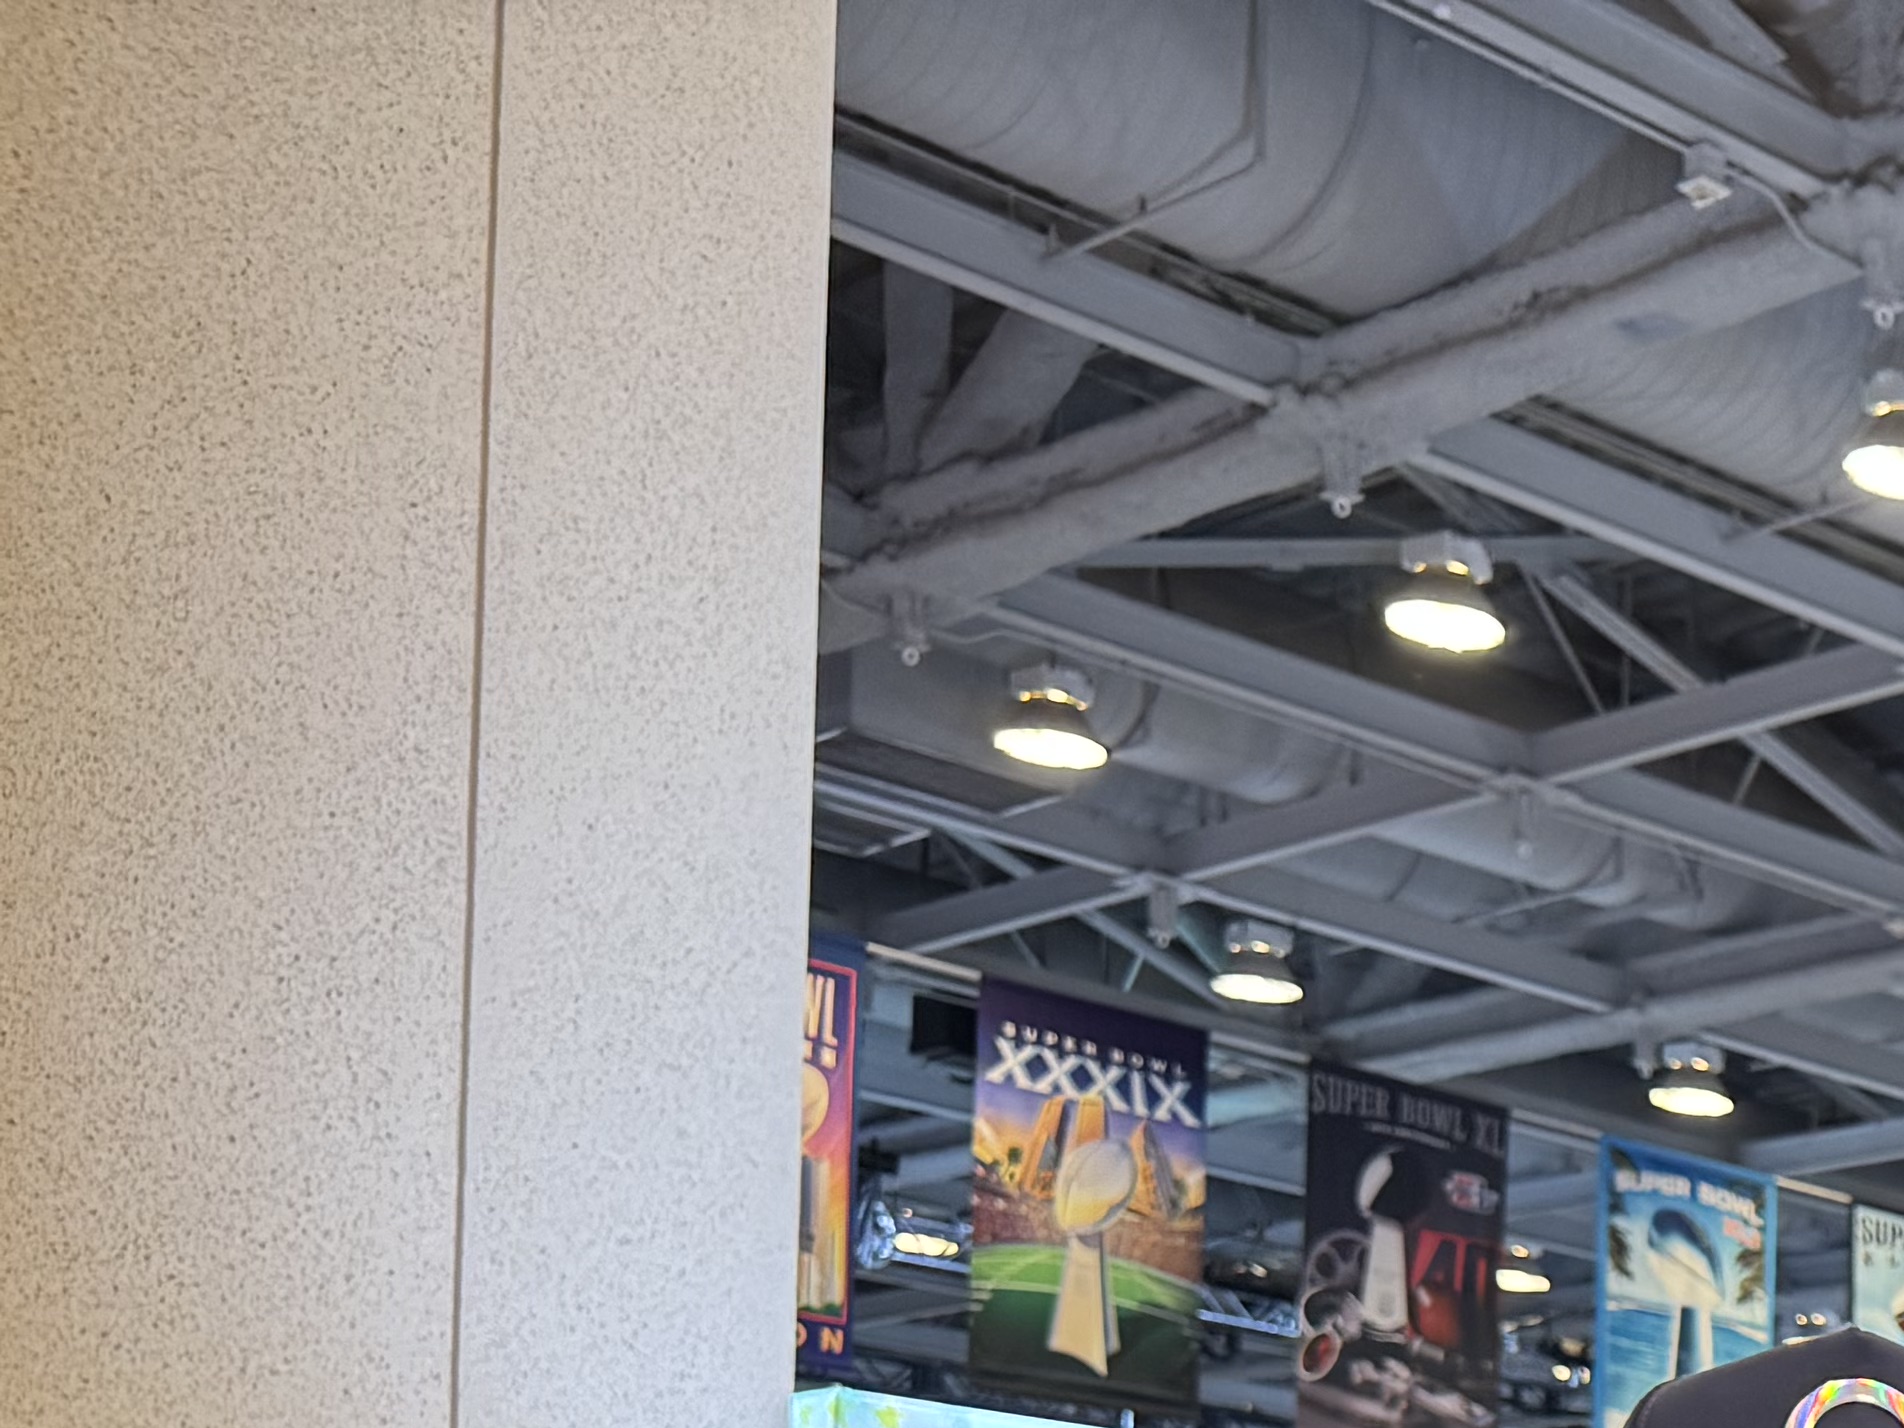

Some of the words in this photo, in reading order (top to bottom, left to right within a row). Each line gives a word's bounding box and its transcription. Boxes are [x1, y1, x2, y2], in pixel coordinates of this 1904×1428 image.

[984, 1035, 1202, 1129] XXXIX
[1001, 1020, 1098, 1057] SUPER
[1110, 1047, 1188, 1080] BOWL
[1311, 1071, 1392, 1119] SUPER
[1400, 1094, 1468, 1143] BOWL
